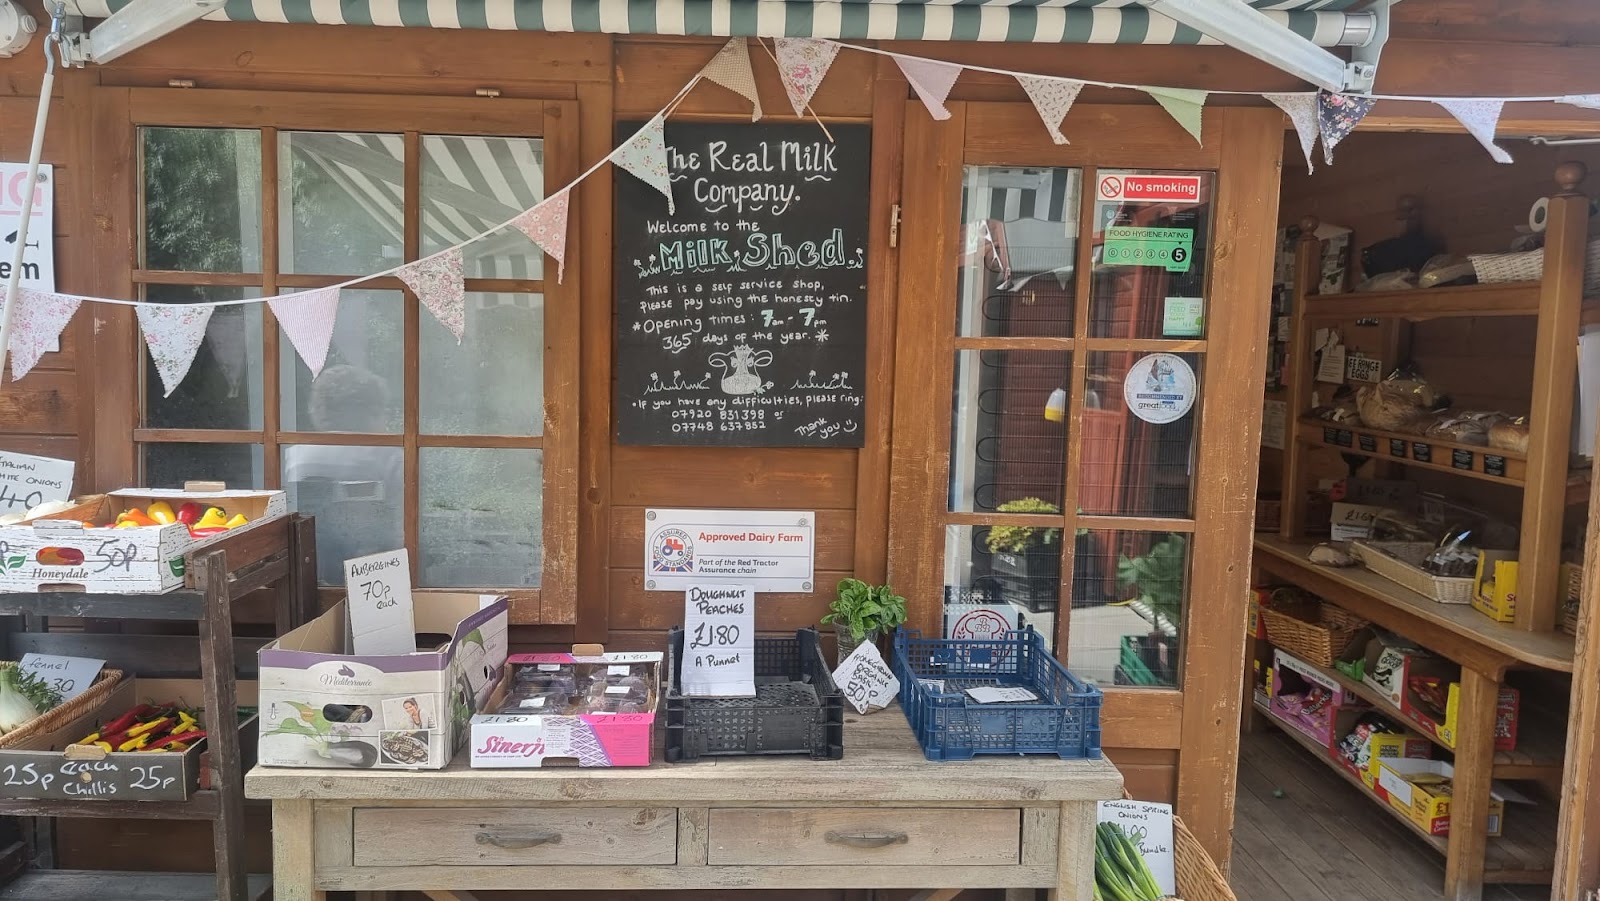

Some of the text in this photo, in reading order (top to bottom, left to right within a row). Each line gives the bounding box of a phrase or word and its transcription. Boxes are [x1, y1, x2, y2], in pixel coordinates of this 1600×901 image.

[666, 141, 837, 172] he Real Milk
[1127, 182, 1196, 195] No smoking
[694, 178, 800, 215] Company.
[647, 220, 760, 233] Welcome to the
[660, 240, 733, 271] Milk
[1175, 249, 1184, 261] 5
[646, 278, 824, 296] This is a self service shop,
[684, 298, 703, 310] pay
[709, 296, 742, 308] using
[747, 294, 768, 303] the
[775, 294, 823, 307] honesty
[829, 293, 852, 302] tin.
[662, 333, 692, 350] 365
[703, 333, 728, 345] days
[735, 333, 747, 343] of
[752, 332, 773, 341] the
[1358, 360, 1379, 371] RANGE
[1352, 369, 1369, 380] EGGS
[653, 400, 671, 410] you
[678, 397, 701, 406] have
[707, 398, 727, 411] any
[732, 395, 803, 407] difficulties,
[672, 409, 712, 419] 07920
[672, 421, 714, 433] 07748
[794, 417, 841, 439] Thank you
[26, 476, 62, 489] ONIONS
[659, 528, 688, 539] ASSURED
[699, 532, 803, 544] Approved Dairy Farm
[351, 557, 400, 577] AUBERGINES
[32, 568, 89, 582] Honeydale
[360, 580, 391, 602] 70p
[689, 587, 746, 602] DOUGHNUT
[376, 598, 398, 610] each
[696, 602, 745, 615] PEACHES
[690, 622, 740, 649] £1.80
[29, 657, 70, 672] fennel
[695, 653, 741, 667] A Punnet
[3, 763, 54, 790] 25p
[130, 766, 175, 790] 25p
[63, 781, 117, 796] Chillis
[1103, 801, 1169, 815] ENGLISH SPRING
[1118, 811, 1148, 821] ONIONS
